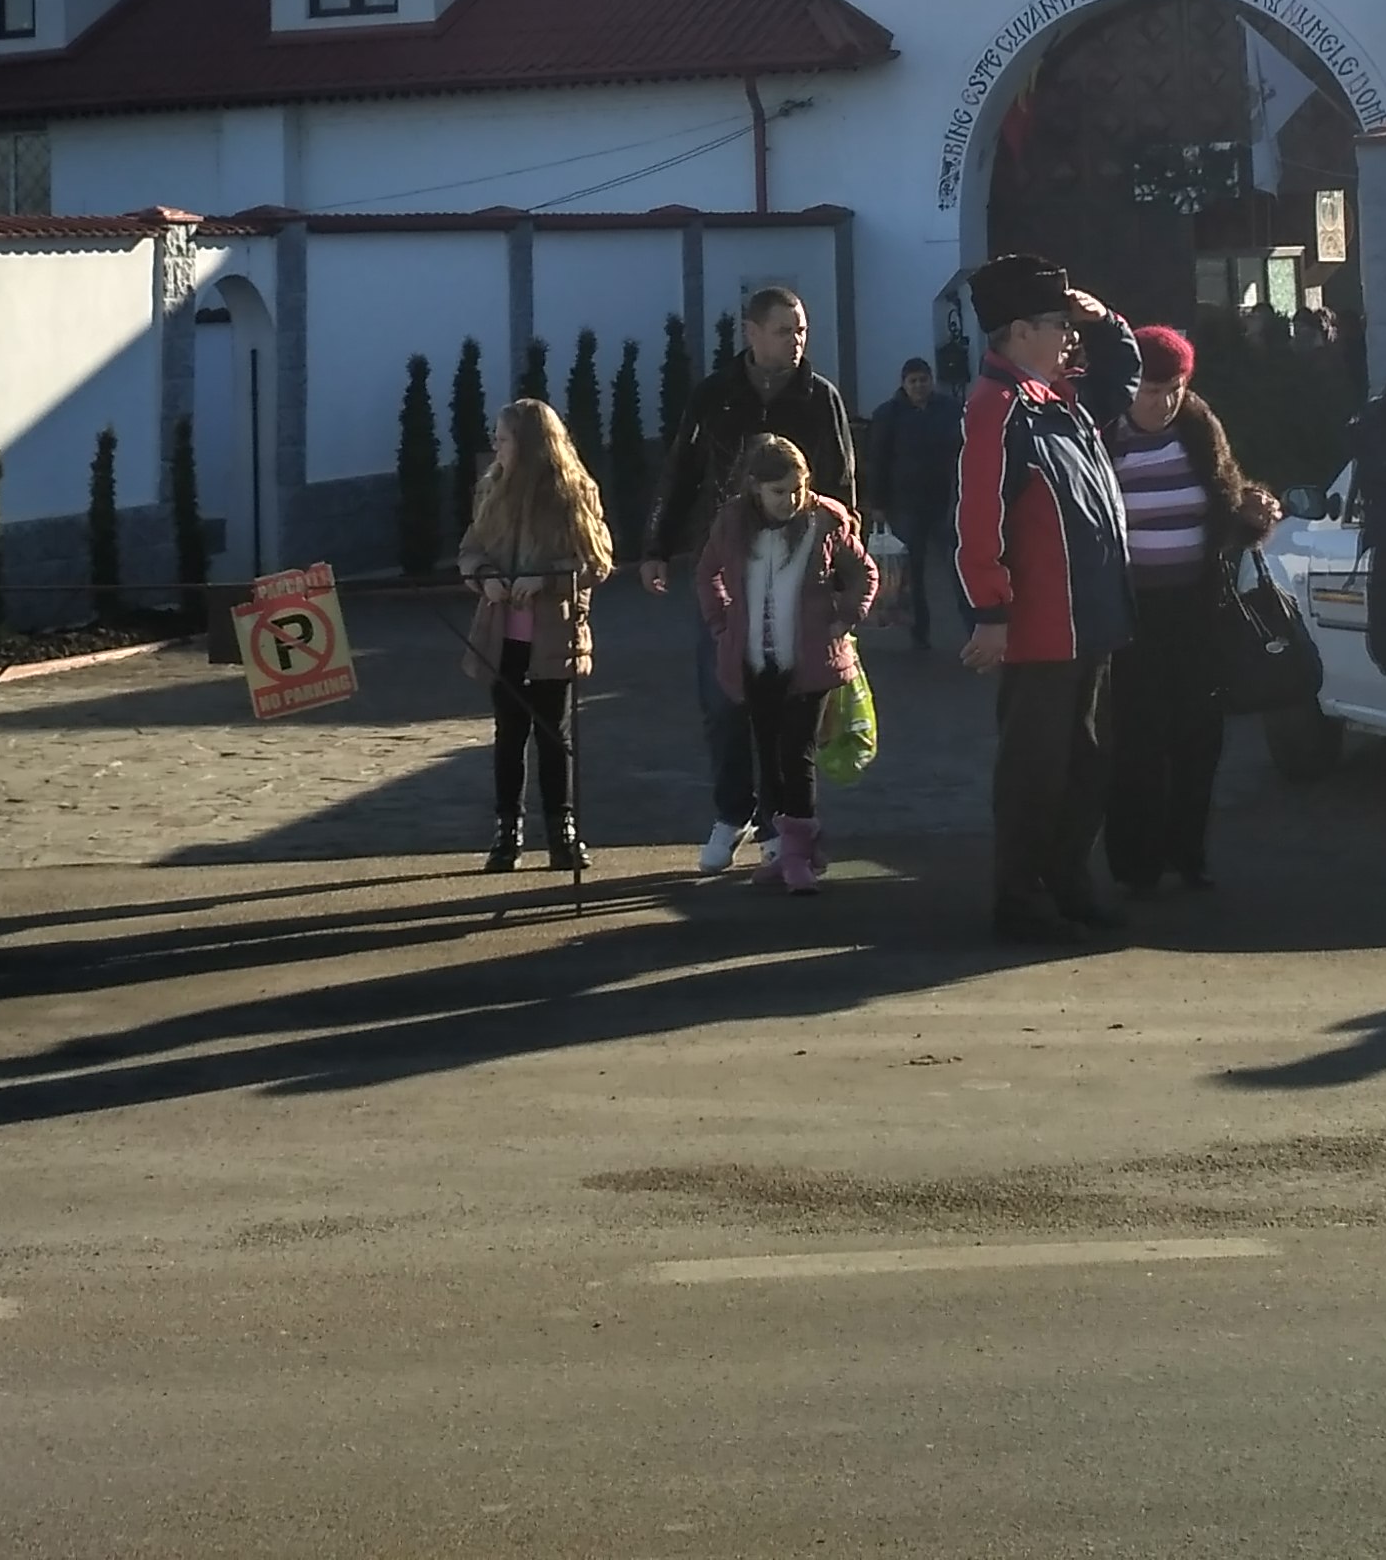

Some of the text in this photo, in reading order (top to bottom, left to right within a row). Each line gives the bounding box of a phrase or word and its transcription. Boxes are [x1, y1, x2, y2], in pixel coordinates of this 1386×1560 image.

[961, 48, 1003, 106] ESTE
[259, 673, 353, 712] NO PARKING
